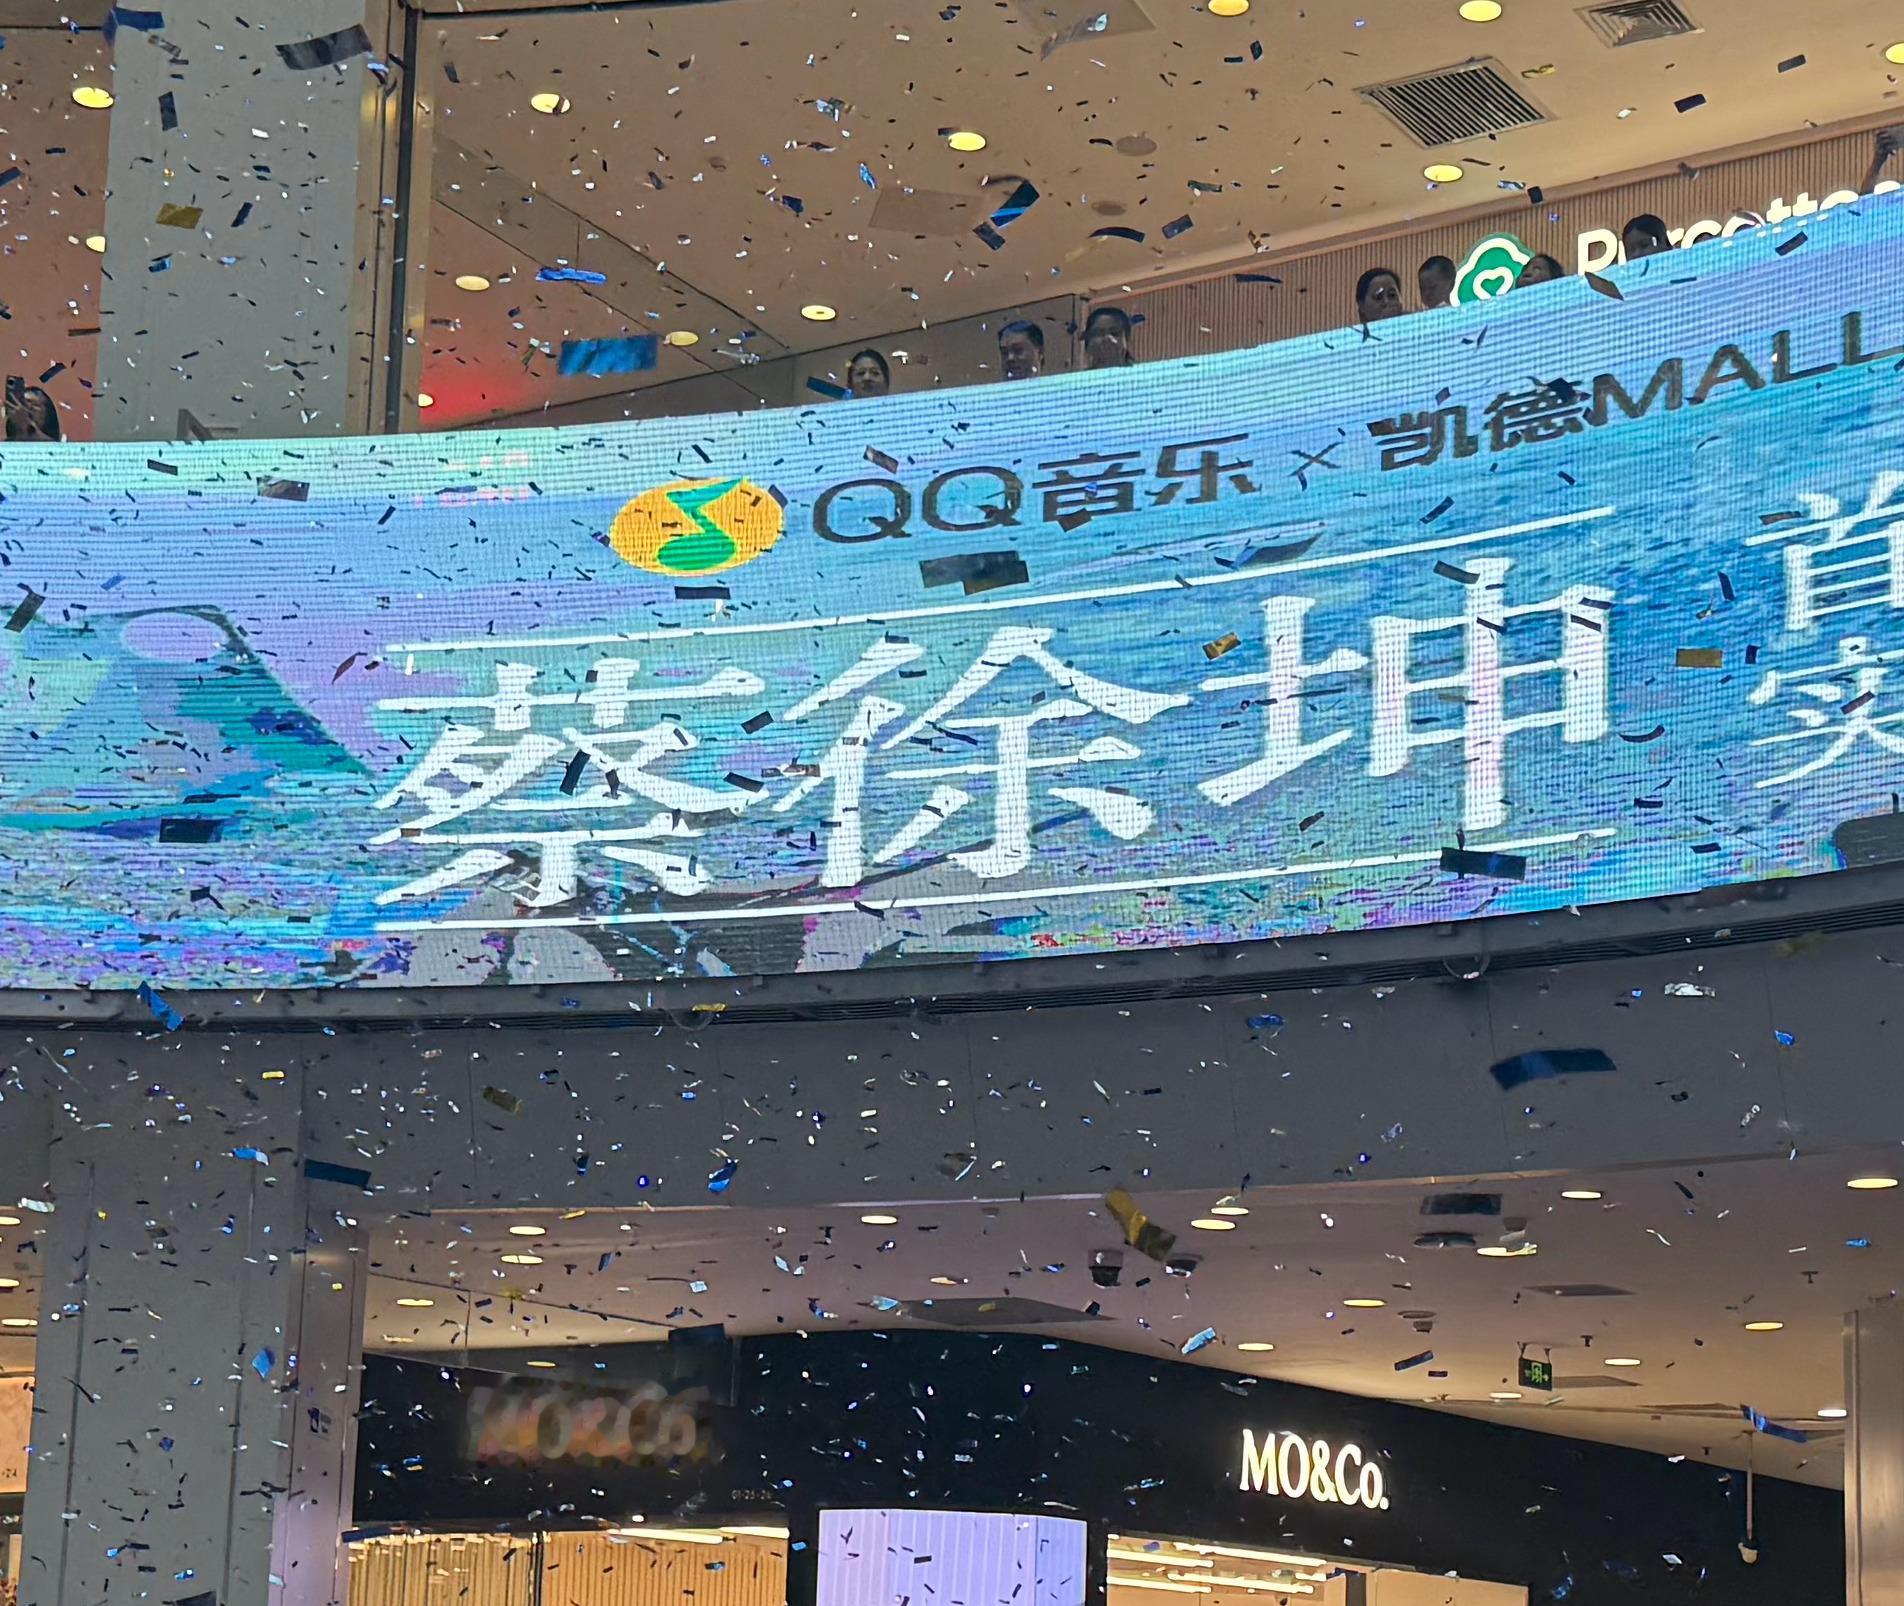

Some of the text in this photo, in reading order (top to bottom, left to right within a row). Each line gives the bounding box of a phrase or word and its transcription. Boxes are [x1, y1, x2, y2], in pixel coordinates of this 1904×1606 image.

[813, 433, 1262, 543] QQ音乐
[368, 558, 1616, 908] 蔡徐坤
[1239, 1428, 1389, 1510] MO&Co.
